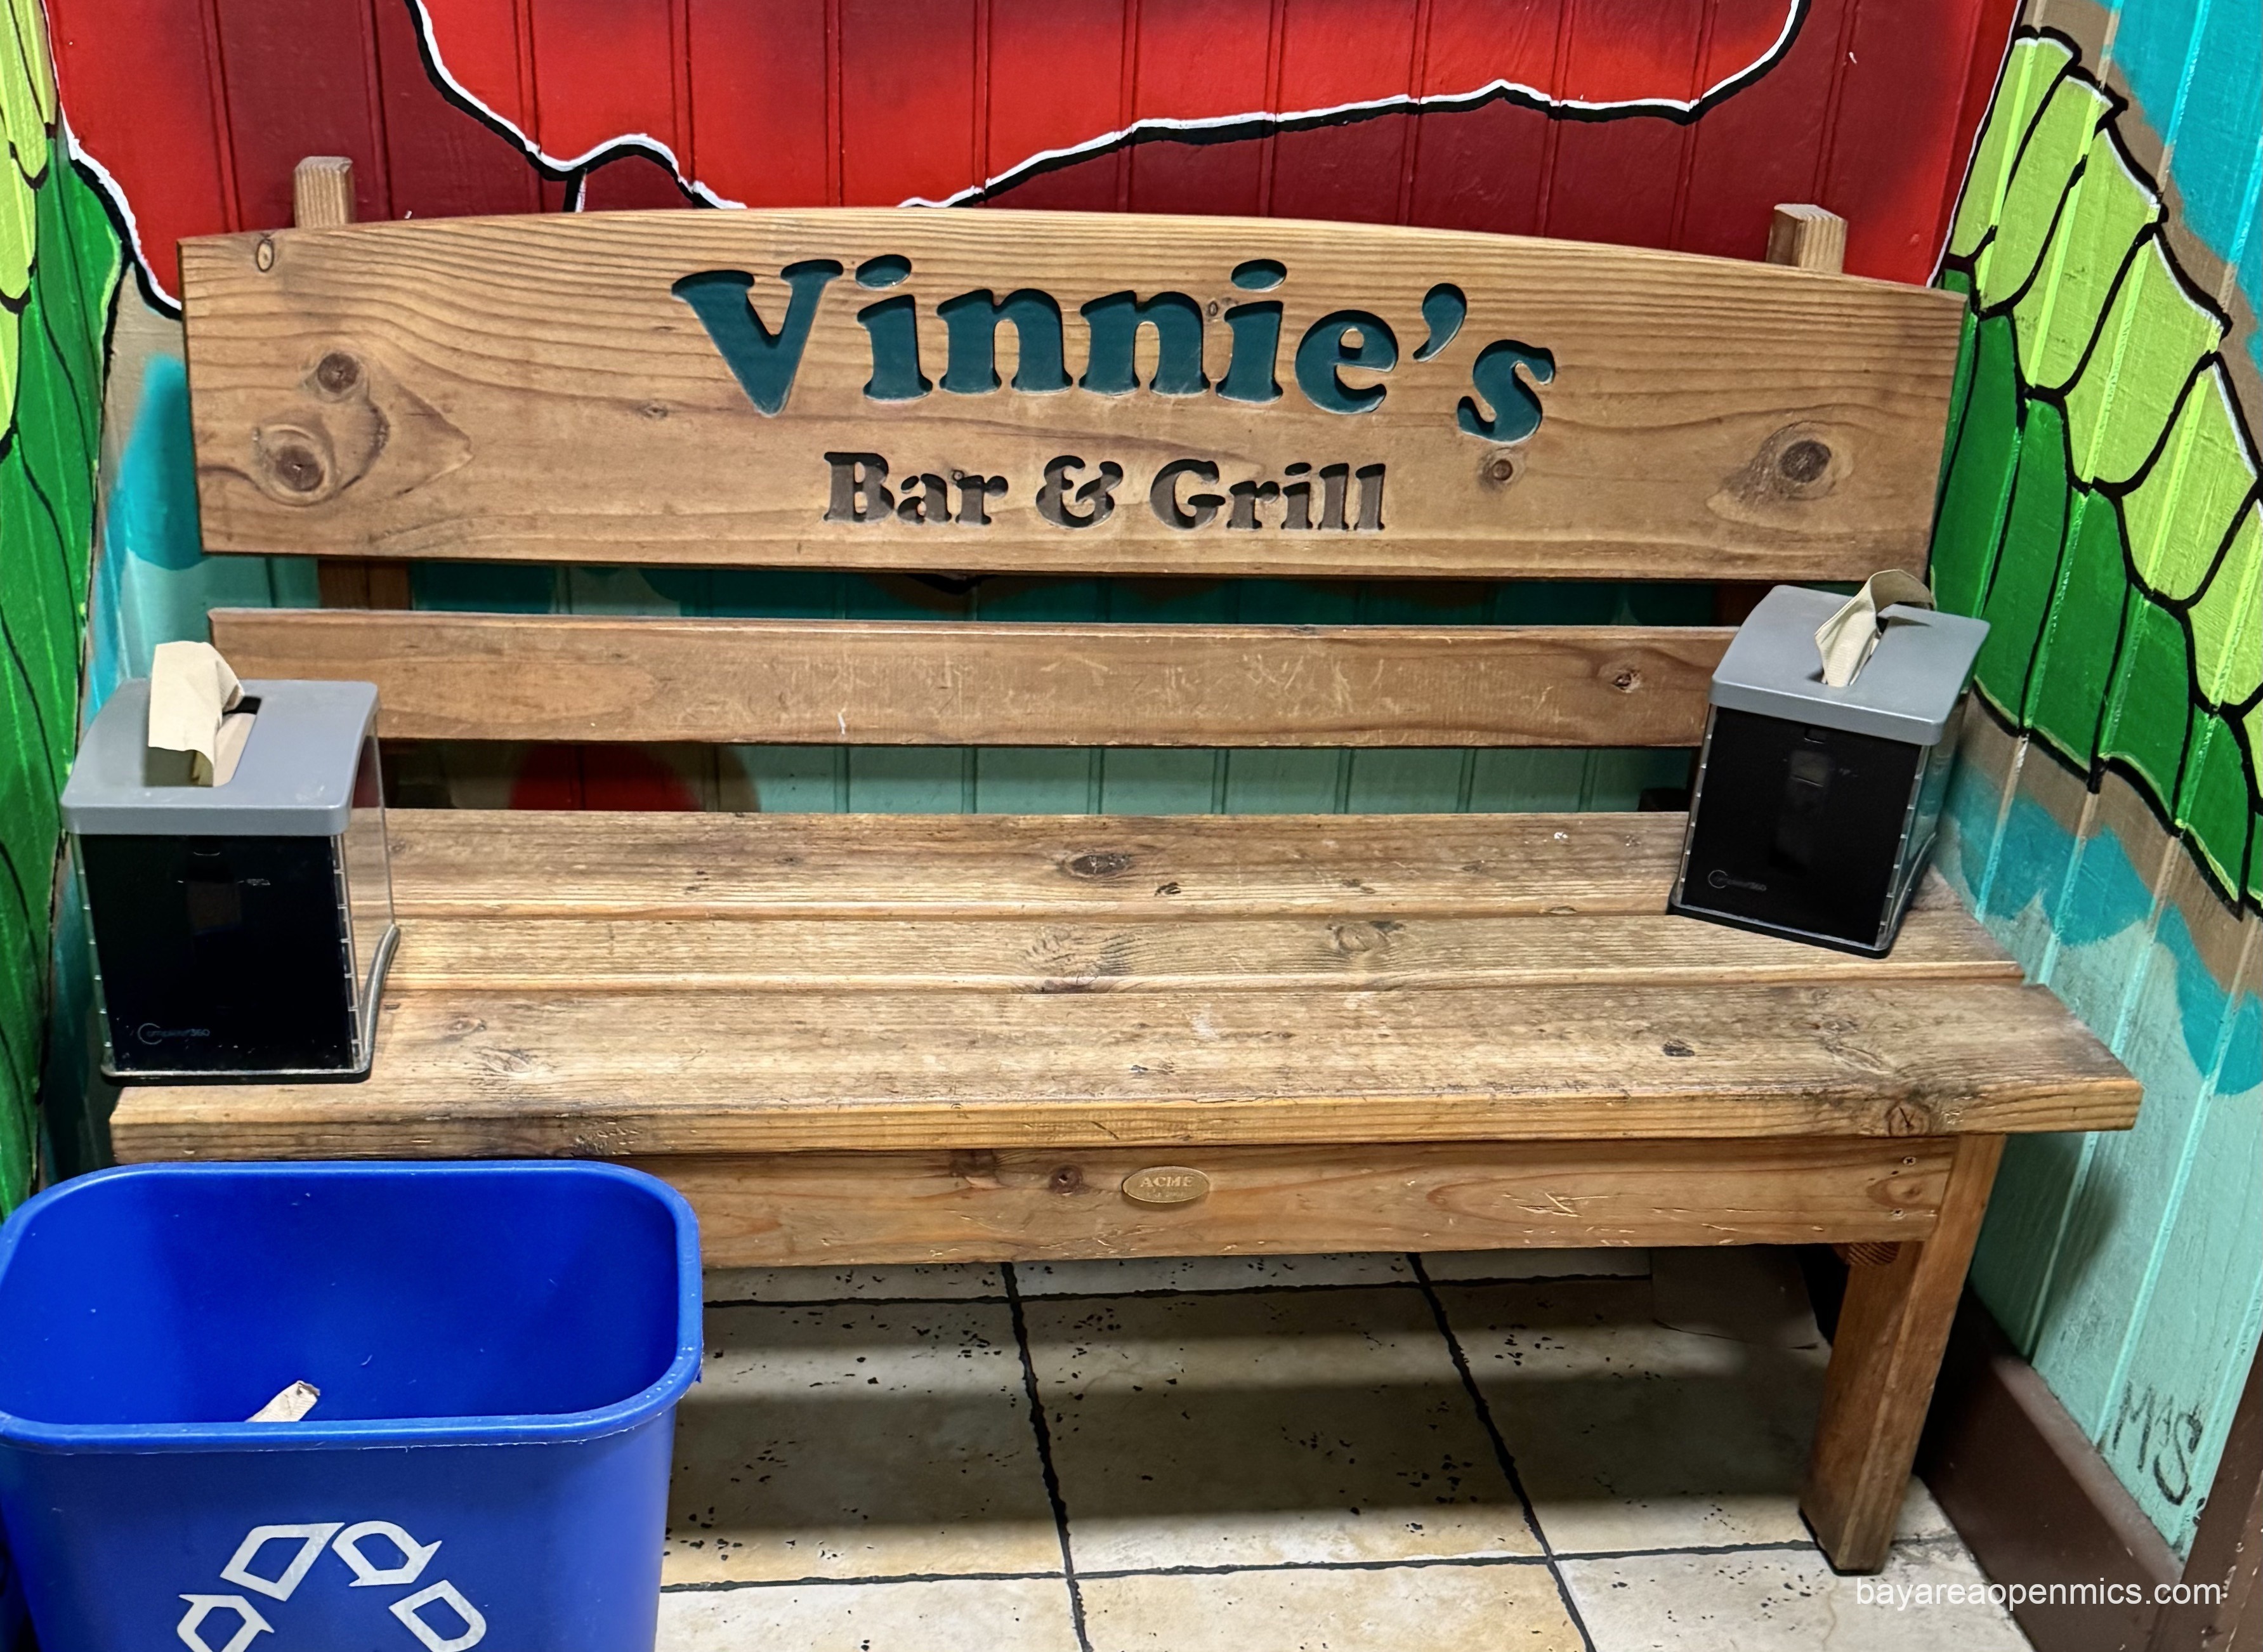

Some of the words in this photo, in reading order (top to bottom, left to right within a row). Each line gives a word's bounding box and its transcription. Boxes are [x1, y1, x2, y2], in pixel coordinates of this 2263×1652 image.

[671, 254, 1556, 444] Vinnie's
[823, 451, 1009, 525] Bar
[1035, 455, 1124, 530] &
[1149, 458, 1386, 531] Grill
[1140, 1176, 1195, 1188] ACME
